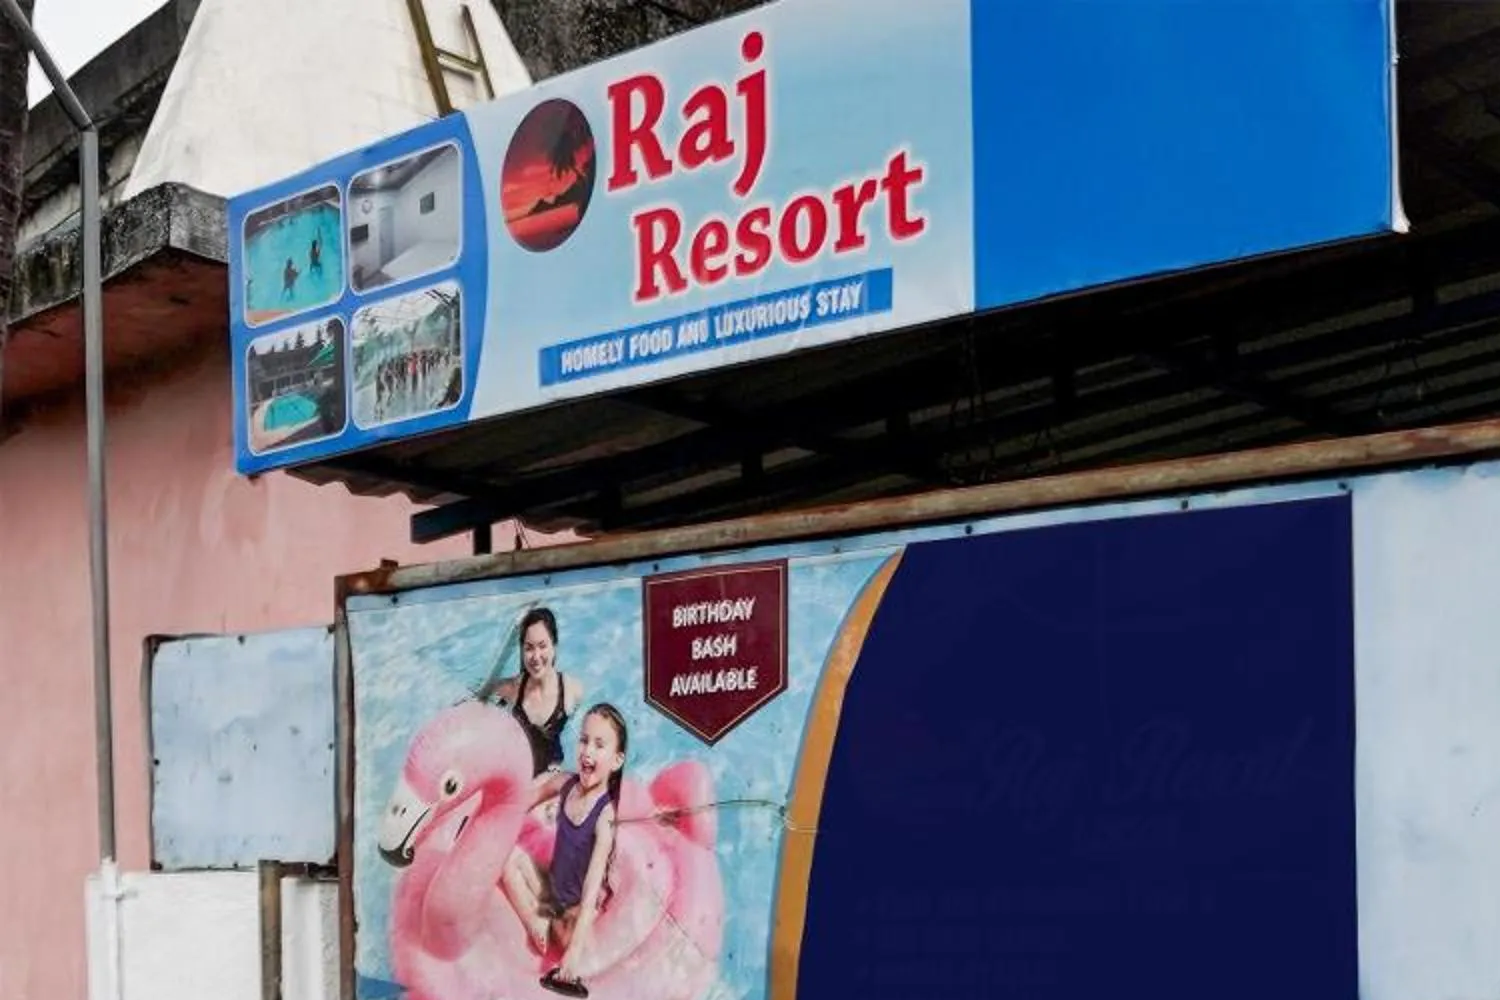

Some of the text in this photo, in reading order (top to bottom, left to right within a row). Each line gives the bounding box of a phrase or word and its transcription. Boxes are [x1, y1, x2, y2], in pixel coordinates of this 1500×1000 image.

[607, 31, 766, 196] Raj
[633, 152, 925, 302] Resort
[560, 281, 863, 374] HOMELY FOOD AND LUXURIOUS STAY
[672, 596, 756, 629] BIRTHDAY
[691, 634, 738, 660] BASH
[669, 666, 759, 697] AVAILABLE
